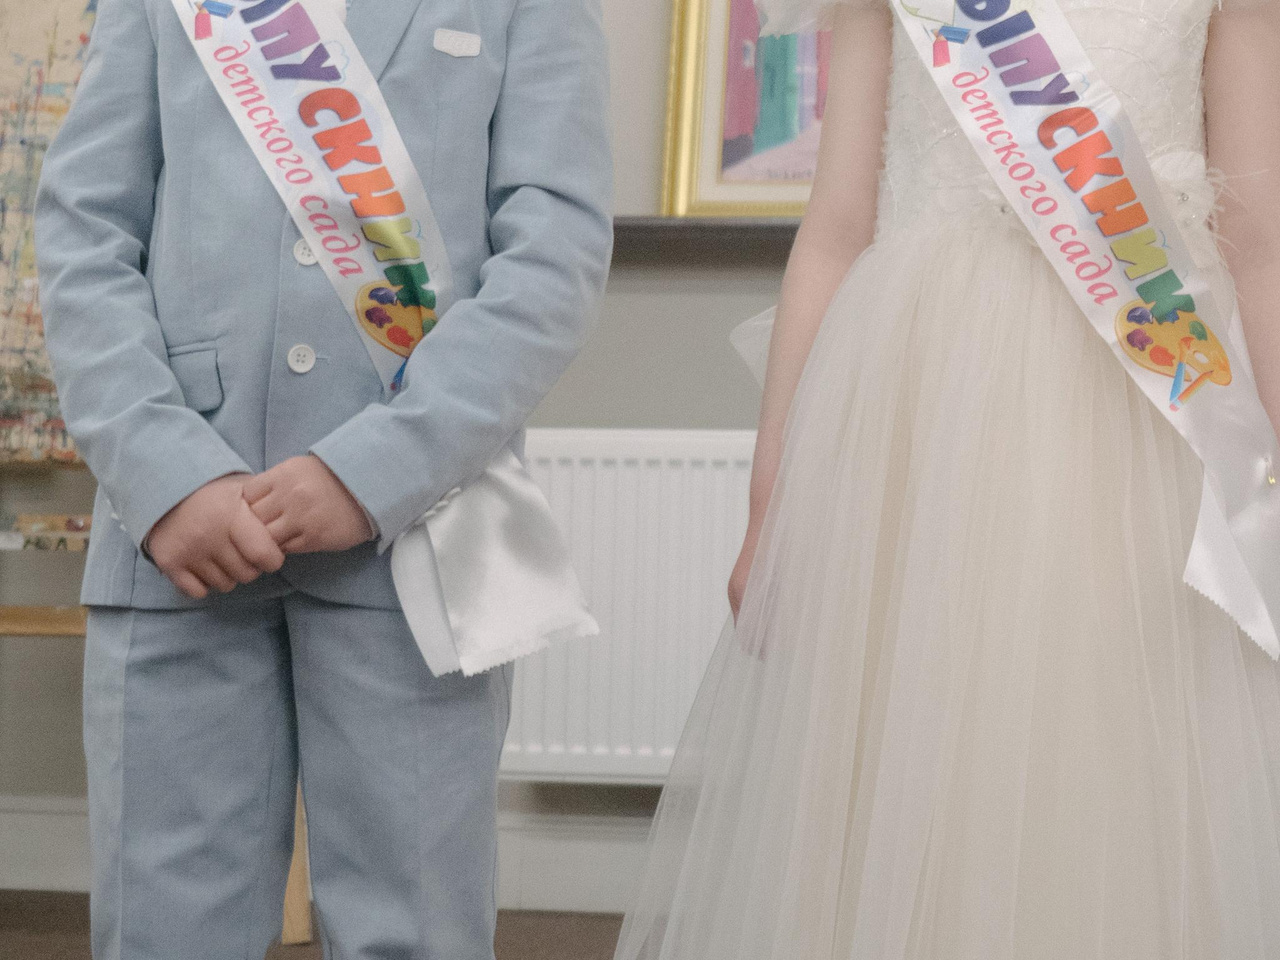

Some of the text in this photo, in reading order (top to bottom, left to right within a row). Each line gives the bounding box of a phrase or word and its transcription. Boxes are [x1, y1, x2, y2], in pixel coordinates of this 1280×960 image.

[214, 40, 364, 278] детского сада
[952, 67, 1118, 306] детского сада
